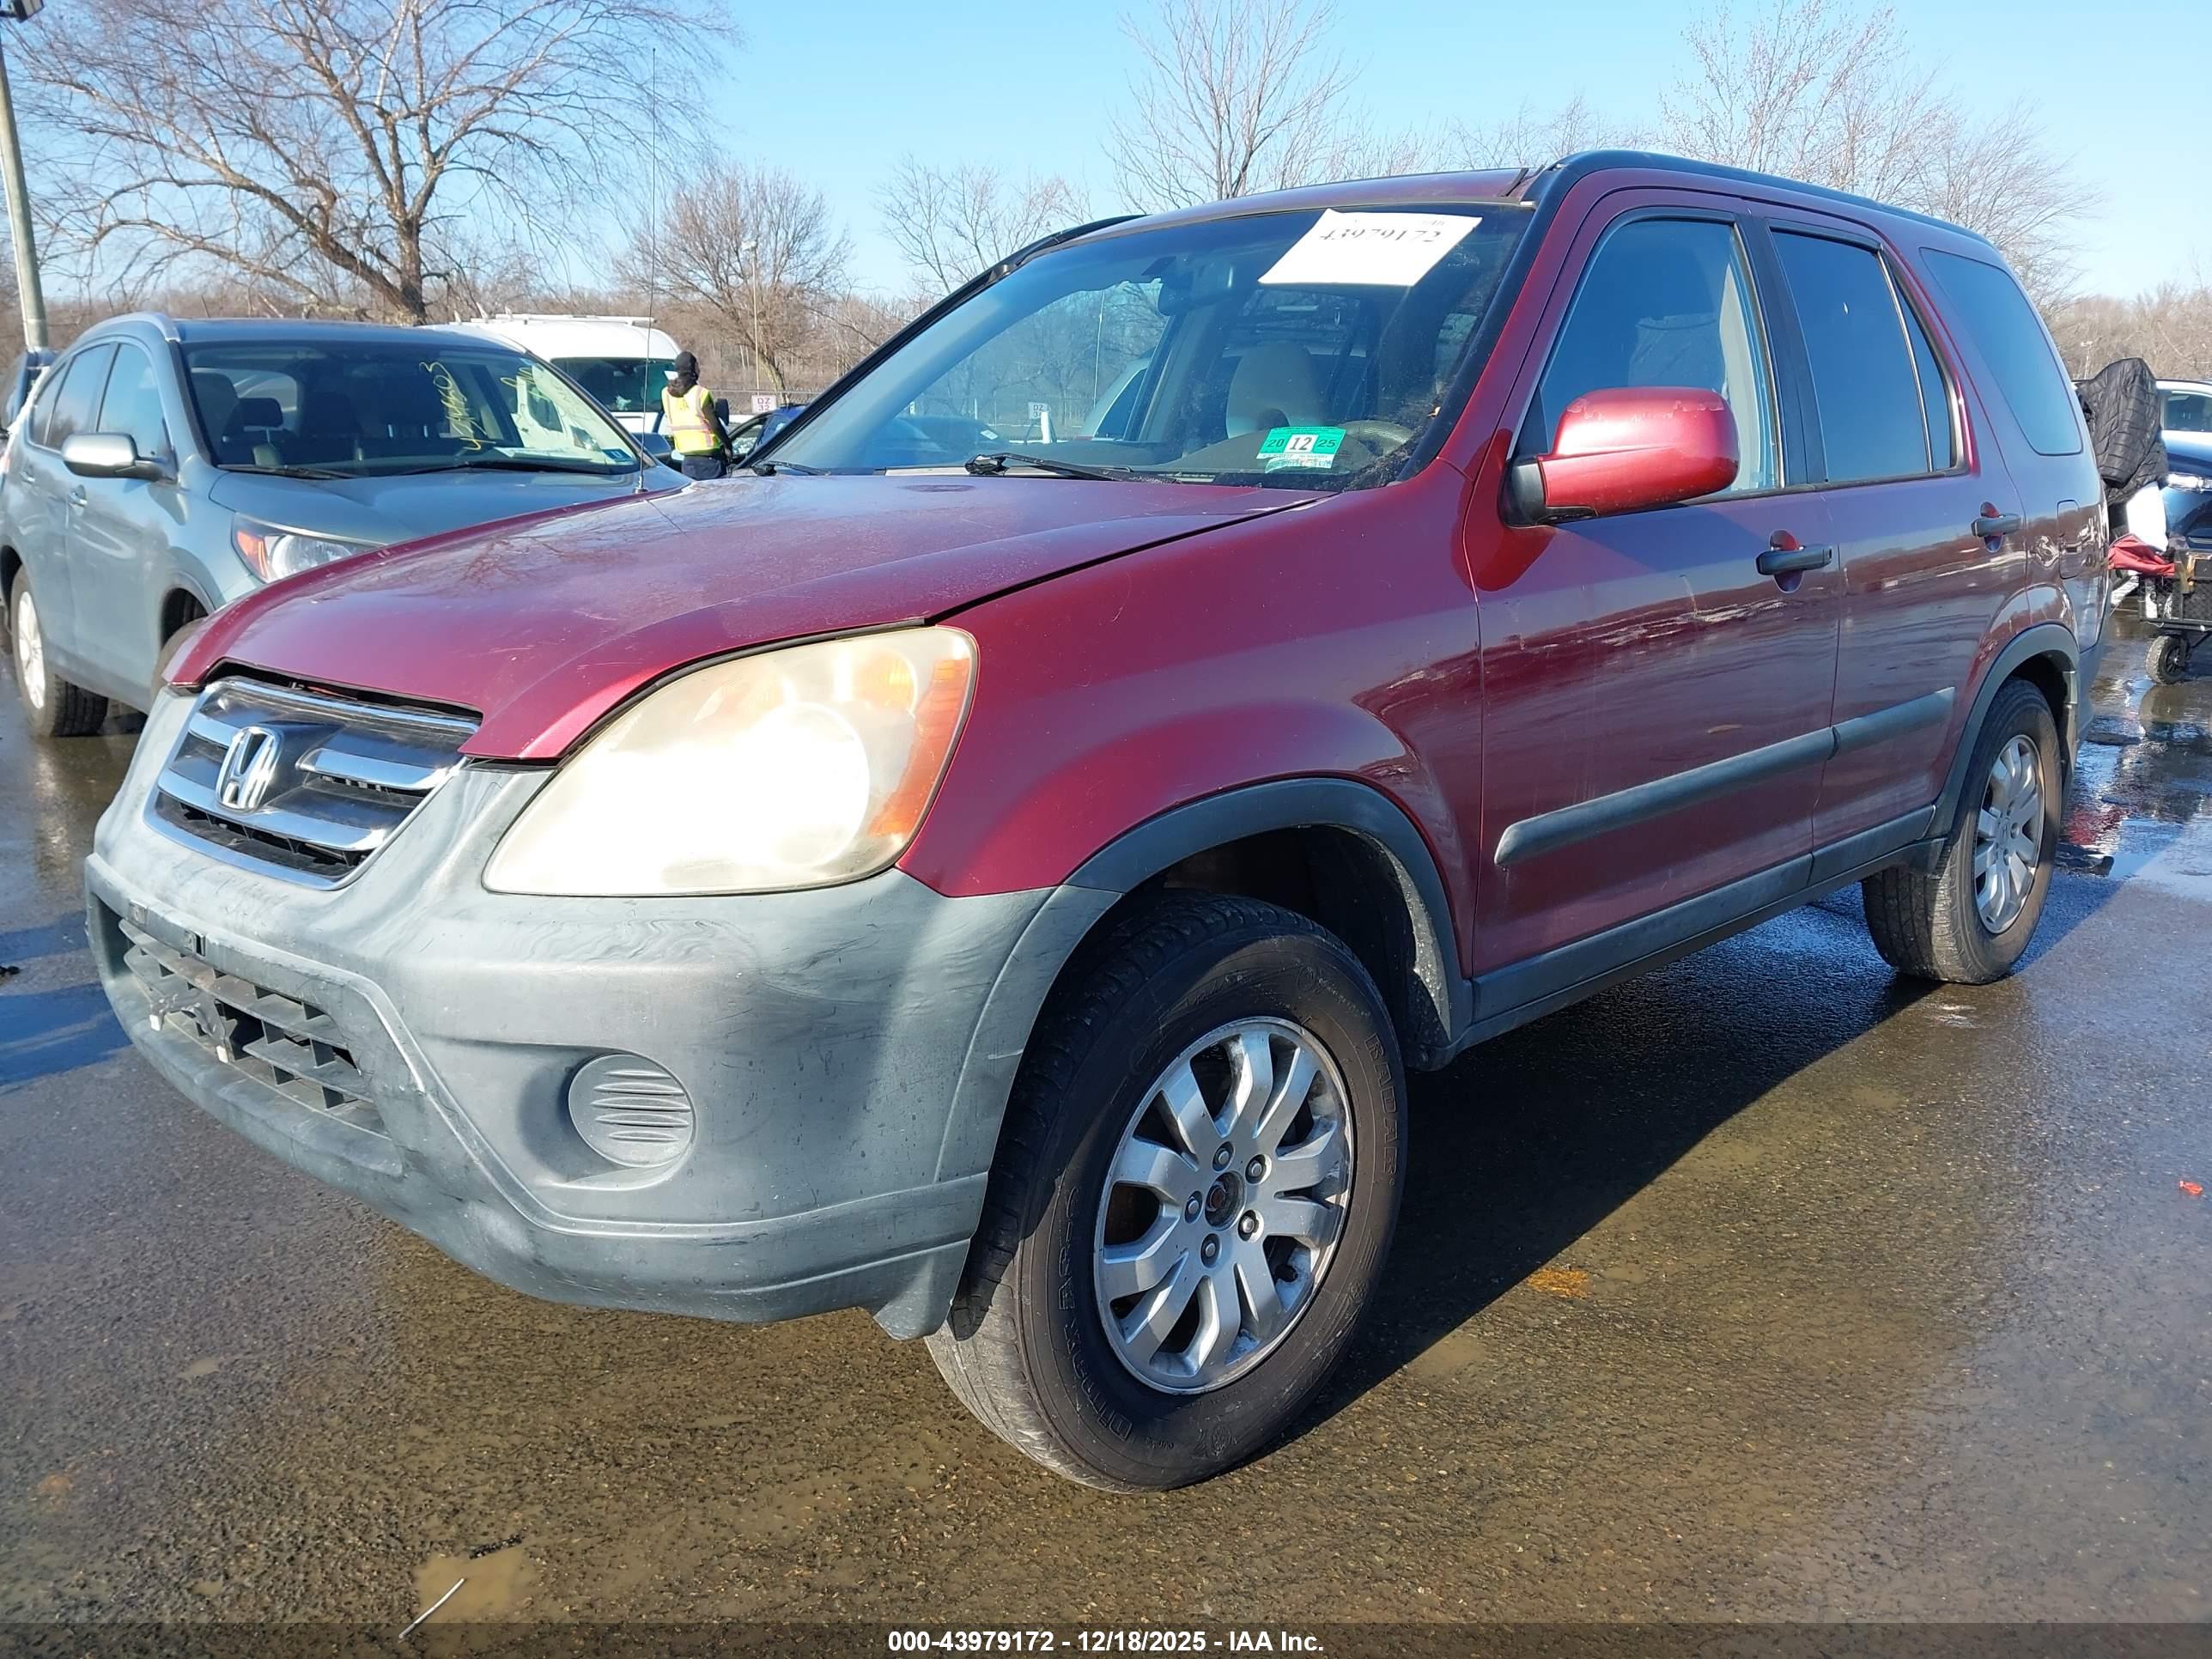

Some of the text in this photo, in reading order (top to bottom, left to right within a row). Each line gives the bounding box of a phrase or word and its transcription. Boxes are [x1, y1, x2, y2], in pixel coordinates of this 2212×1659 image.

[1318, 228, 1443, 243] 43979172
[1267, 437, 1336, 451] 20 12 25
[1364, 1032, 1399, 1176] RADAR
